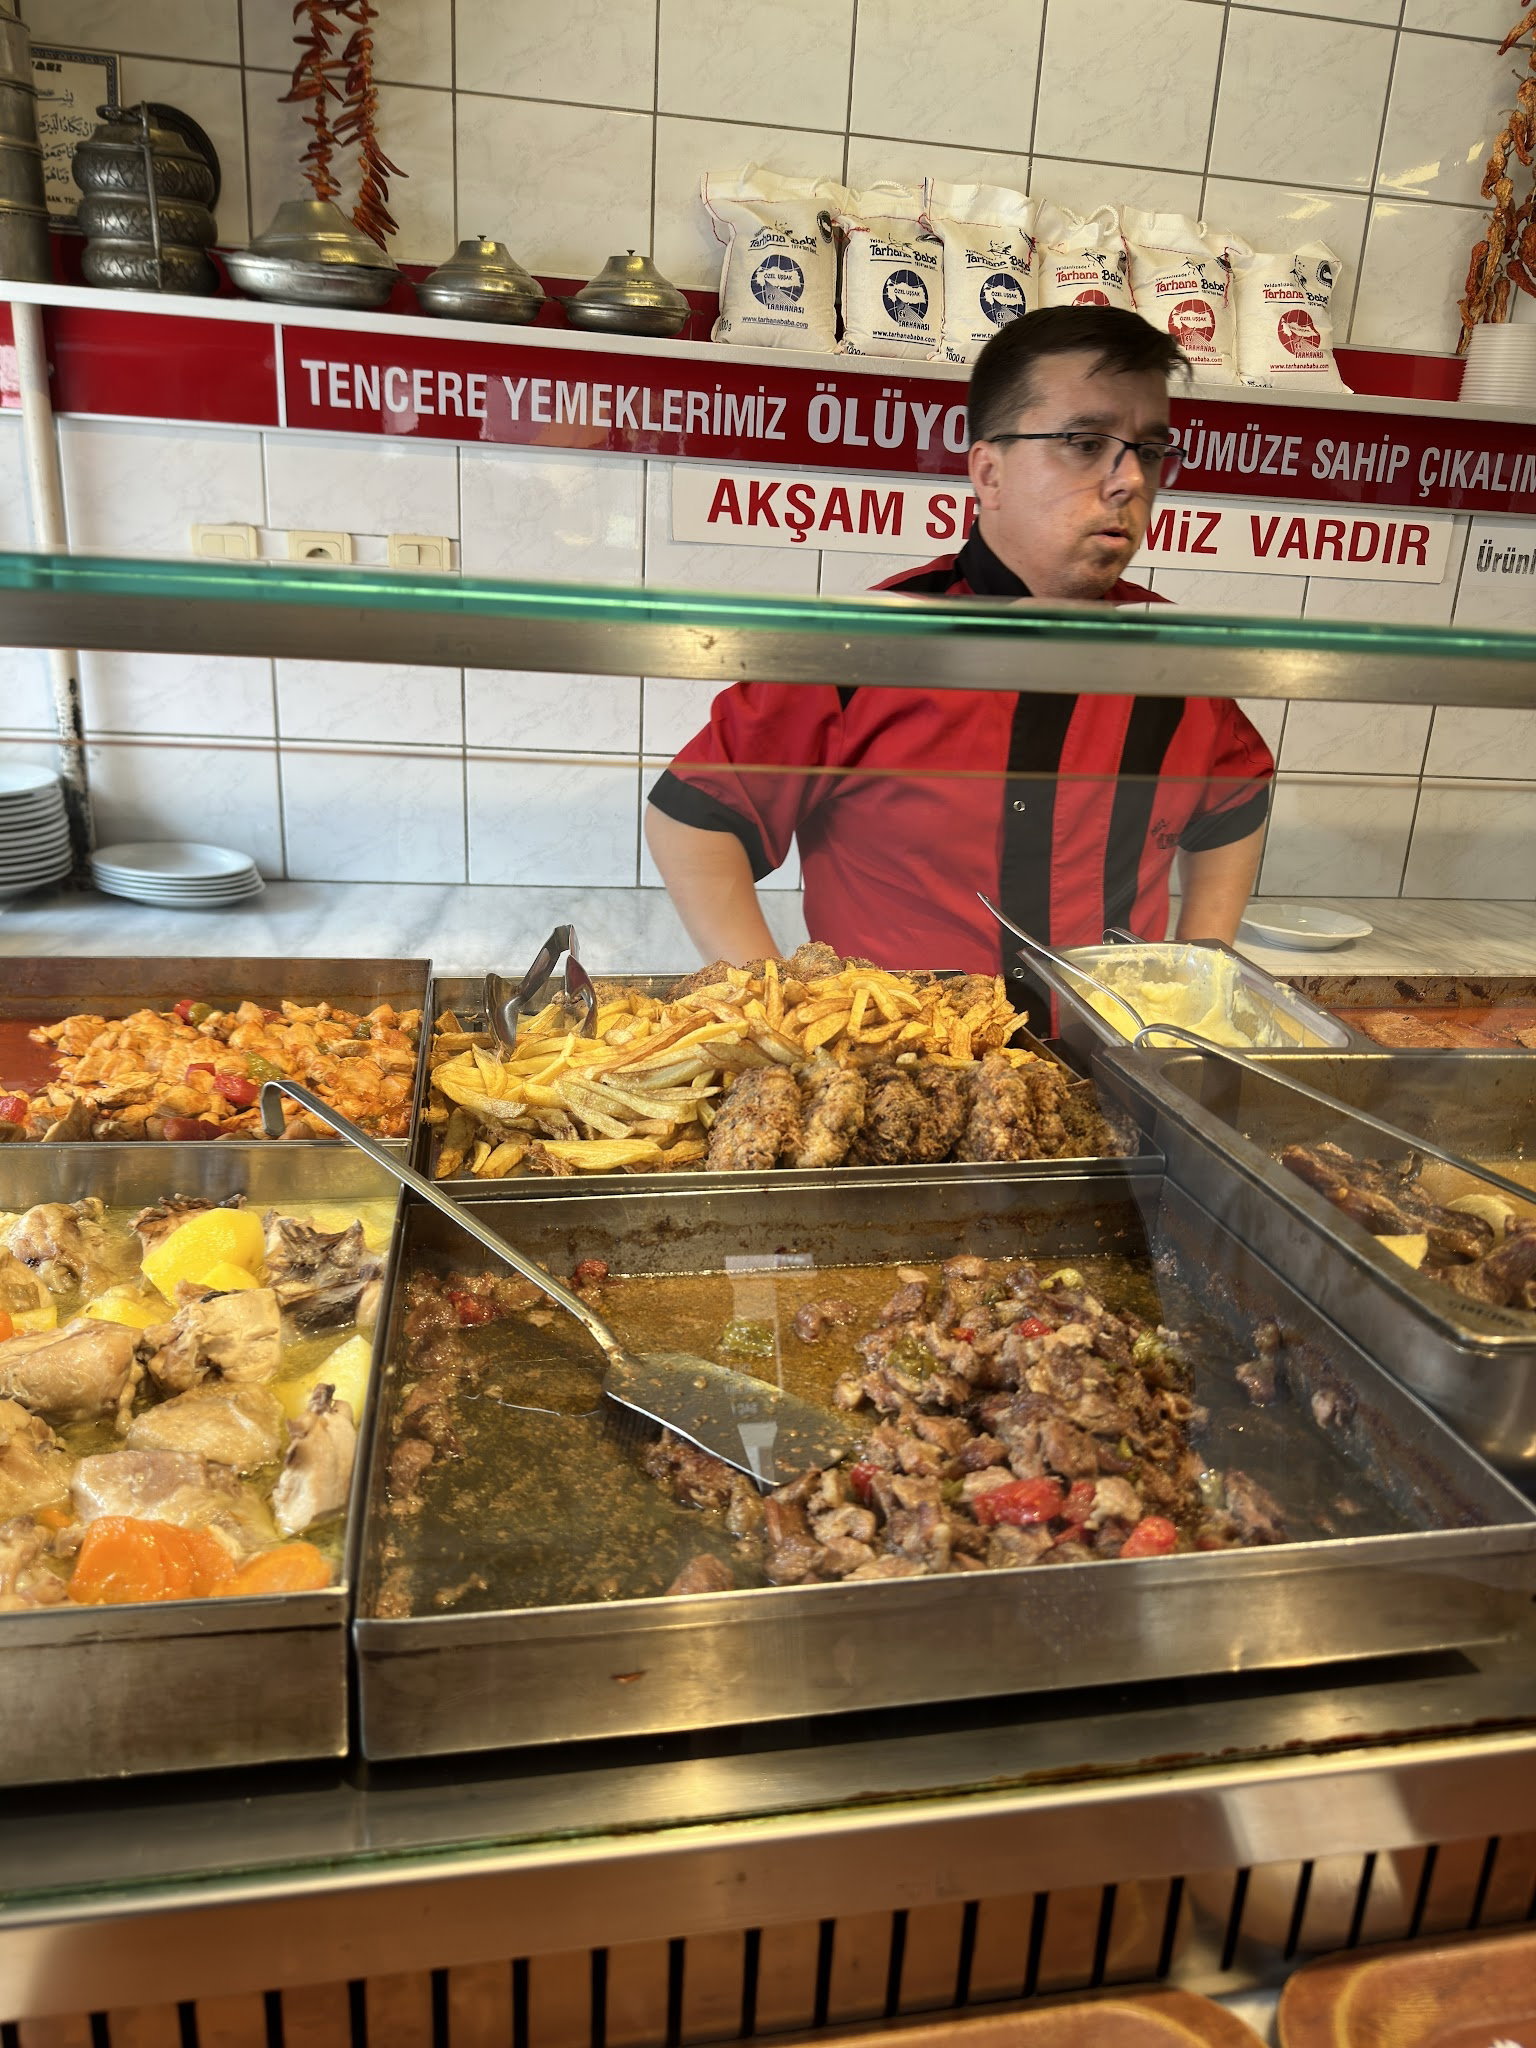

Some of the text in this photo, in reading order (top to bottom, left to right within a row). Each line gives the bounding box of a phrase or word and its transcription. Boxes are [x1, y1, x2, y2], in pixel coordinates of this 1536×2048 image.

[1056, 270, 1098, 283] Tarhana
[1155, 280, 1198, 293] Tarhana
[1262, 289, 1304, 299] Tarhana
[872, 330, 937, 343] www.tarhanababa.com
[946, 352, 960, 363] 1000
[1270, 362, 1329, 370] www.tarhanababa.com
[301, 358, 488, 419] TENCERE
[501, 375, 787, 441] YEMEKLERİMİZ
[1169, 419, 1303, 476] ÜMÜZE
[1311, 434, 1410, 484] SAHİP
[706, 478, 904, 543] AKŞAM
[1250, 515, 1431, 566] VARDIR
